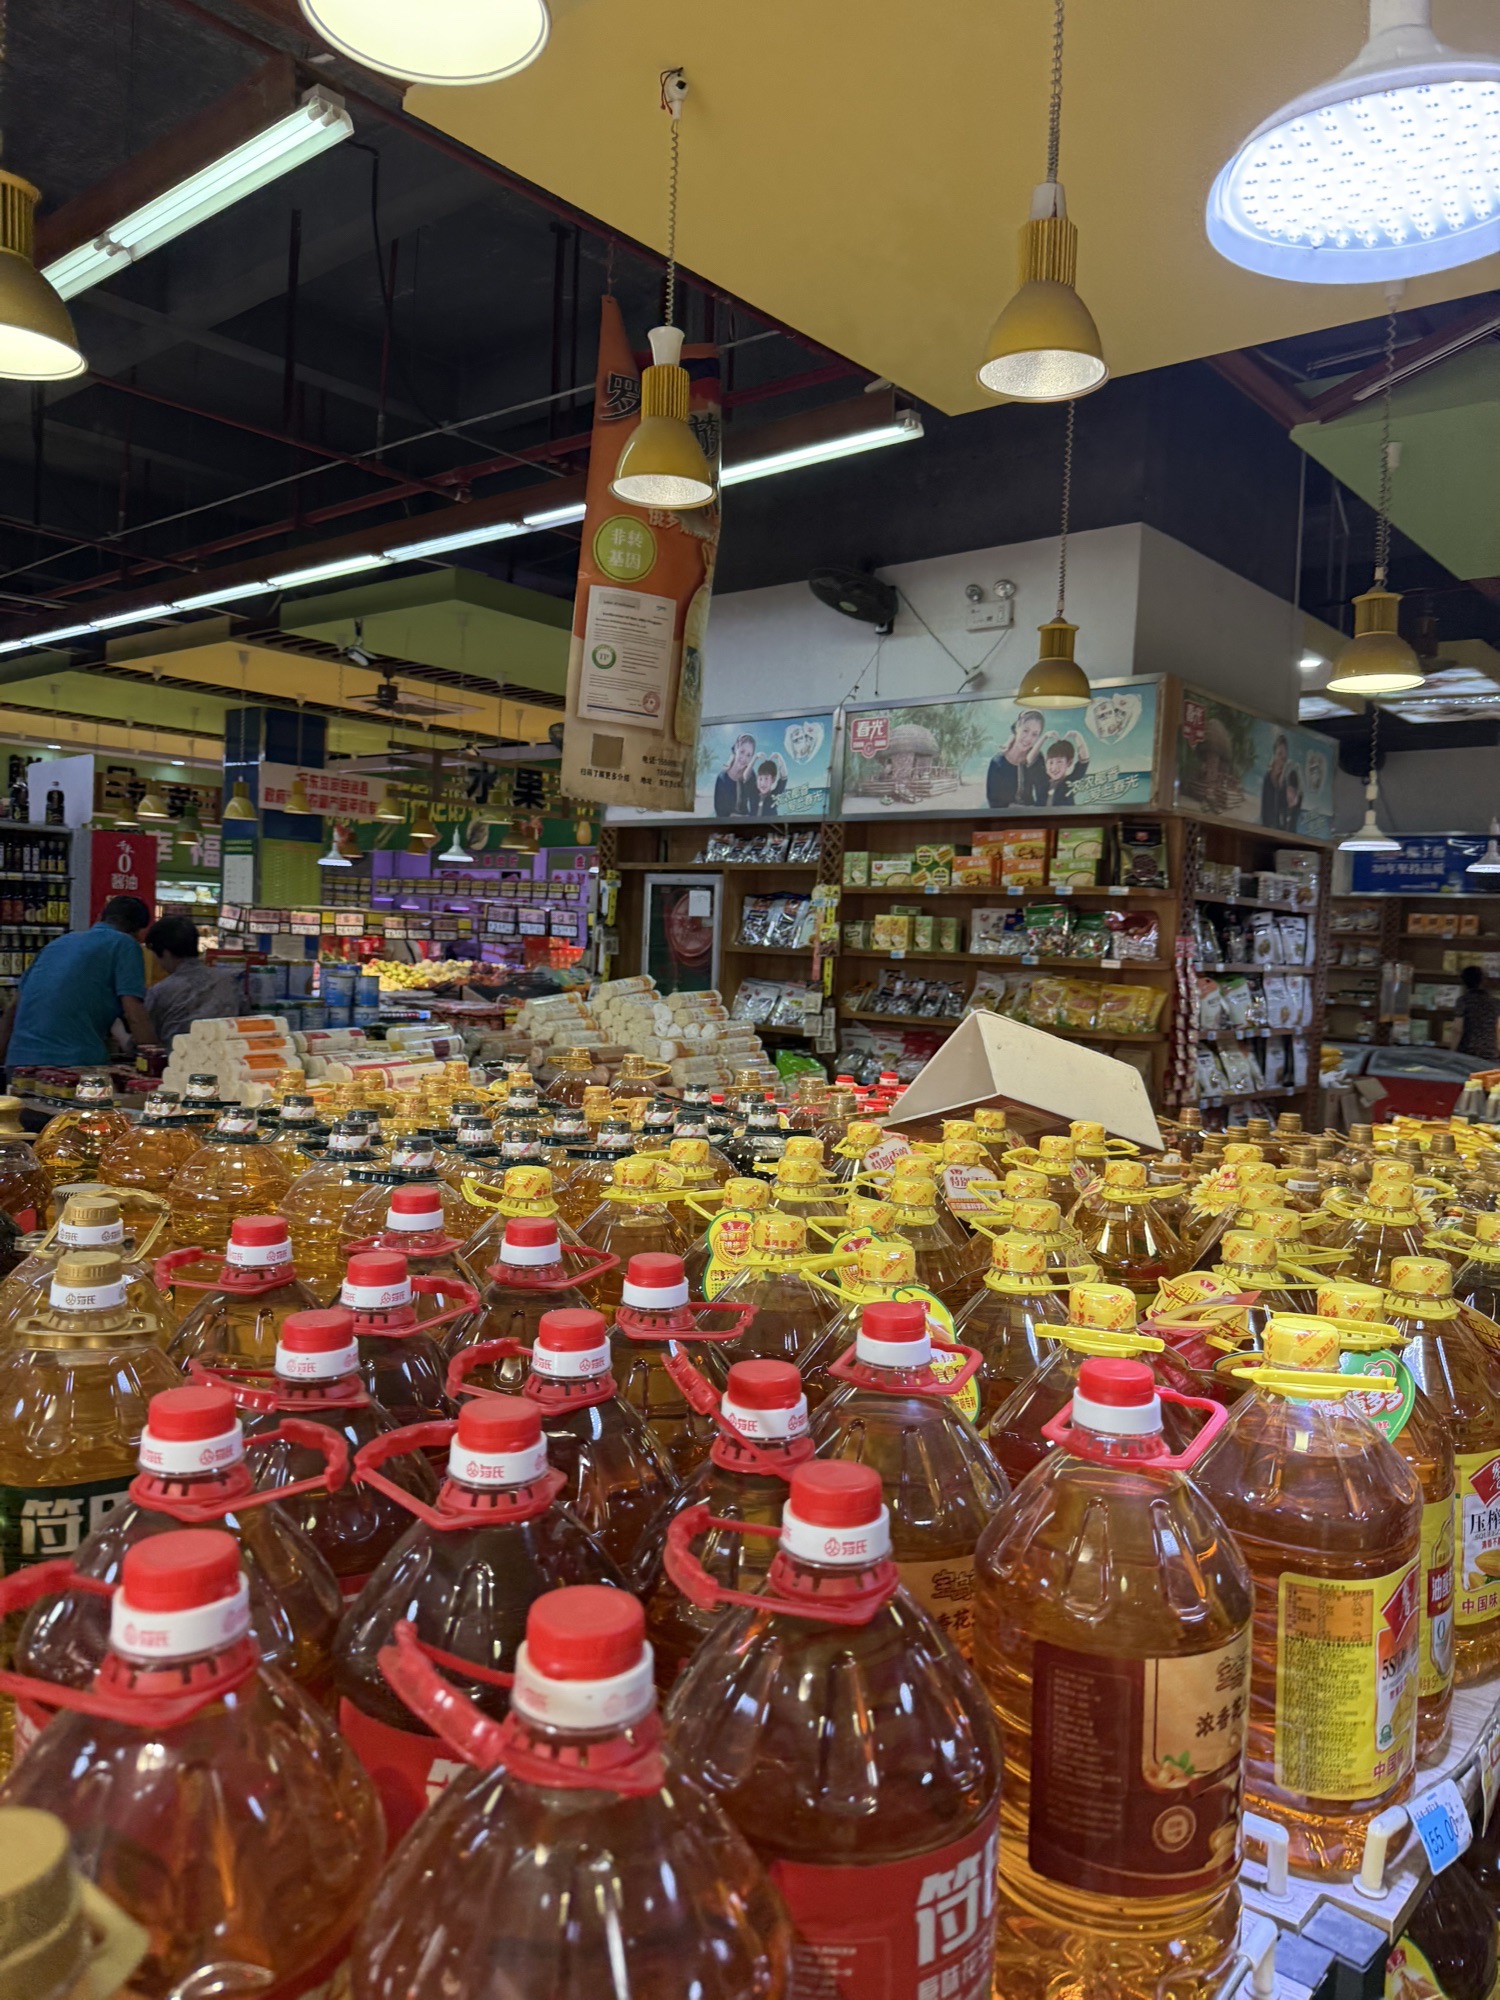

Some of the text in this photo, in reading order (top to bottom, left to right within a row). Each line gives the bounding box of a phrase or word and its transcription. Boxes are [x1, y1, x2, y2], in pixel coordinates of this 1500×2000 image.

[611, 528, 643, 548] 非转
[608, 549, 642, 570] 基因
[857, 718, 884, 739] 春光
[465, 762, 546, 810] 水果
[1064, 766, 1121, 797] 浓浓椰香
[118, 853, 132, 873] 0
[1461, 1590, 1498, 1616] 中国味
